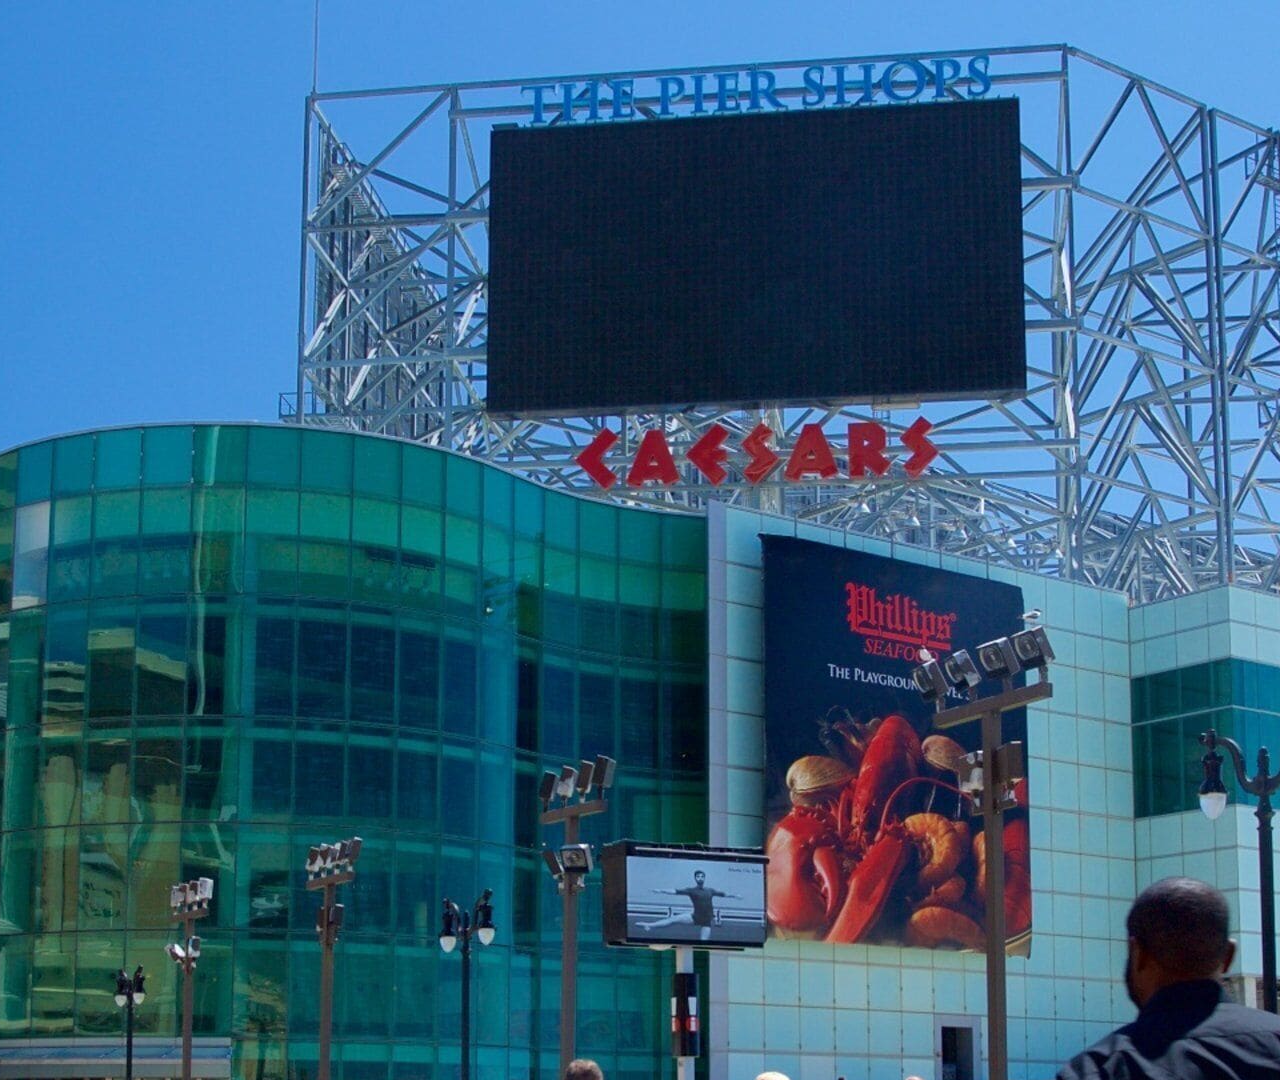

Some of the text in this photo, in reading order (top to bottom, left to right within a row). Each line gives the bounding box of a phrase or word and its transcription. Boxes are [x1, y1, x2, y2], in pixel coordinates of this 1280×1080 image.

[520, 54, 991, 126] THE PIER SHOPS
[575, 416, 939, 490] CAESARS
[845, 582, 953, 645] Phillips
[827, 663, 850, 680] THE
[854, 667, 920, 691] PLAYGROUN
